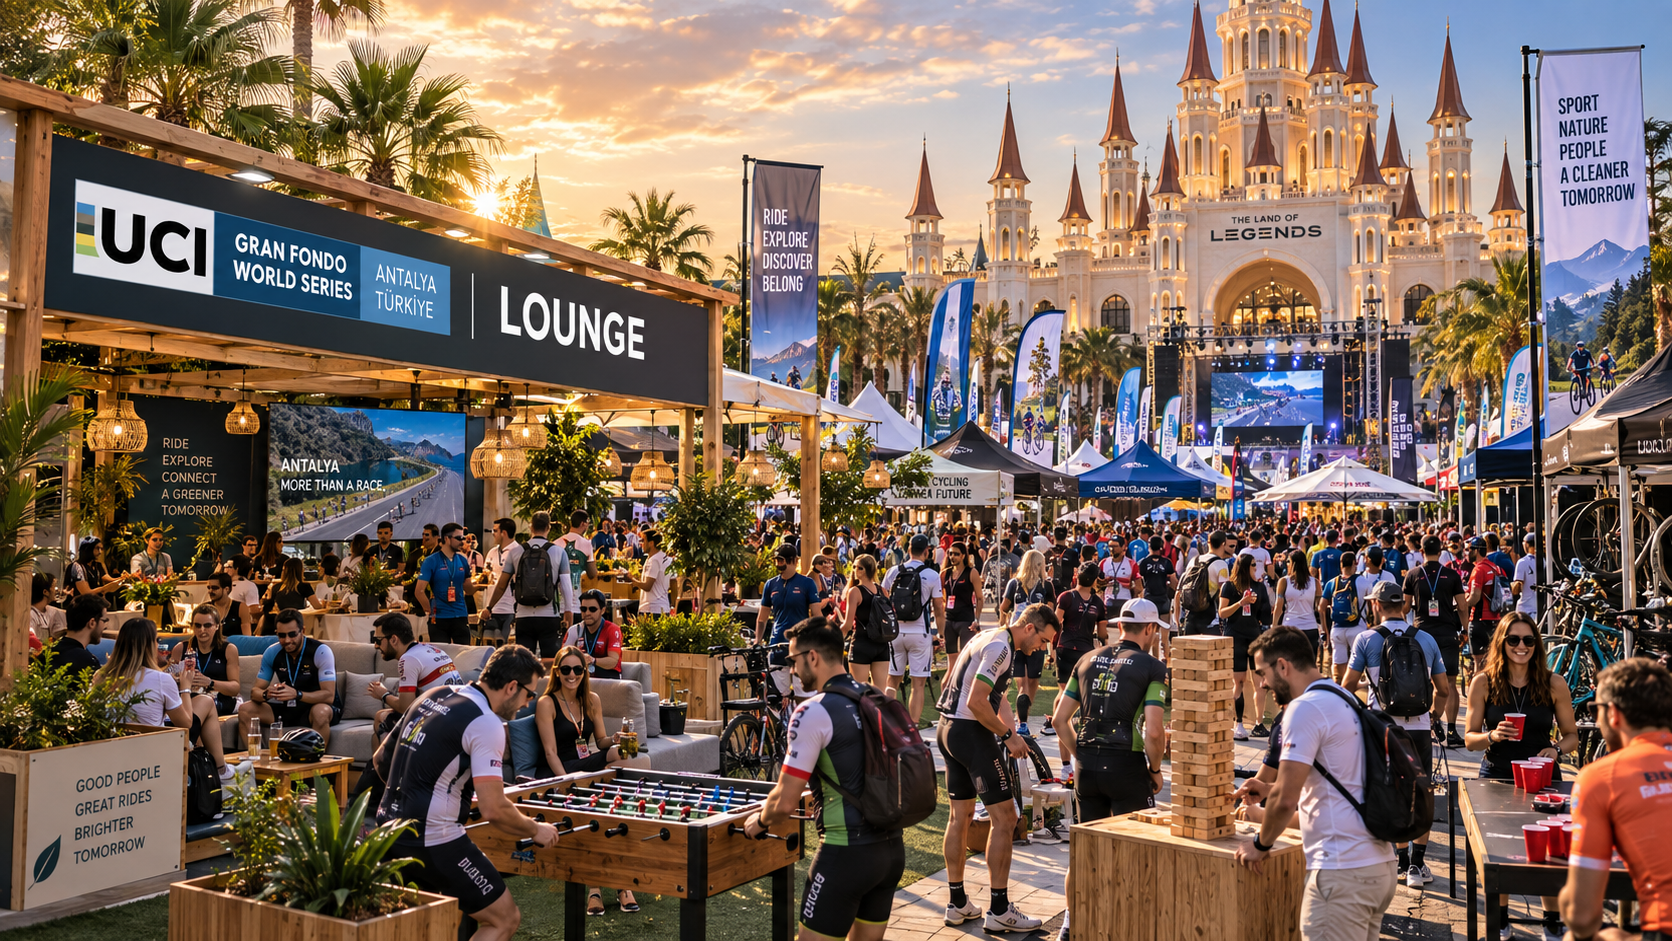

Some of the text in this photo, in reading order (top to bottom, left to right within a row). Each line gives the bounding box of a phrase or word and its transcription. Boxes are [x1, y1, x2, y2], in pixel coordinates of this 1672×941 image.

[1558, 94, 1600, 115] SPORT
[1559, 116, 1608, 138] NATURE
[1560, 140, 1607, 161] PEOPLE
[1560, 161, 1629, 184] A CLEANER
[1560, 183, 1635, 207] TOMORROW
[763, 208, 788, 225] RIDE
[1232, 214, 1299, 224] THE LAND OF
[101, 207, 207, 277] UCI
[763, 230, 808, 248] EXPLORE
[1211, 225, 1322, 242] LEGENDS
[235, 233, 347, 273] GRAN FONDO
[763, 252, 812, 269] DISCOVER
[233, 260, 353, 301] WORLD SERIES
[375, 264, 437, 294] ANTALYA
[763, 275, 803, 292] BELONG
[376, 289, 434, 319] TÜRKİYE
[501, 285, 645, 361] LOUNGE
[163, 438, 189, 450] RIDE
[162, 455, 213, 468] EXPLORE
[280, 458, 340, 473] ANTALYA
[162, 472, 217, 484] CONNECT
[281, 479, 387, 492] MORE THAN A RACE.
[932, 476, 969, 487] CYCLING
[161, 489, 224, 500] A GREENER
[936, 488, 972, 499] FUTURE
[162, 505, 229, 516] TOMORROW
[76, 765, 161, 793] GOOD PEOPLE
[75, 789, 152, 817] GREAT RIDES
[75, 816, 134, 841] BRIGHTER
[73, 835, 146, 865] TOMORROW
